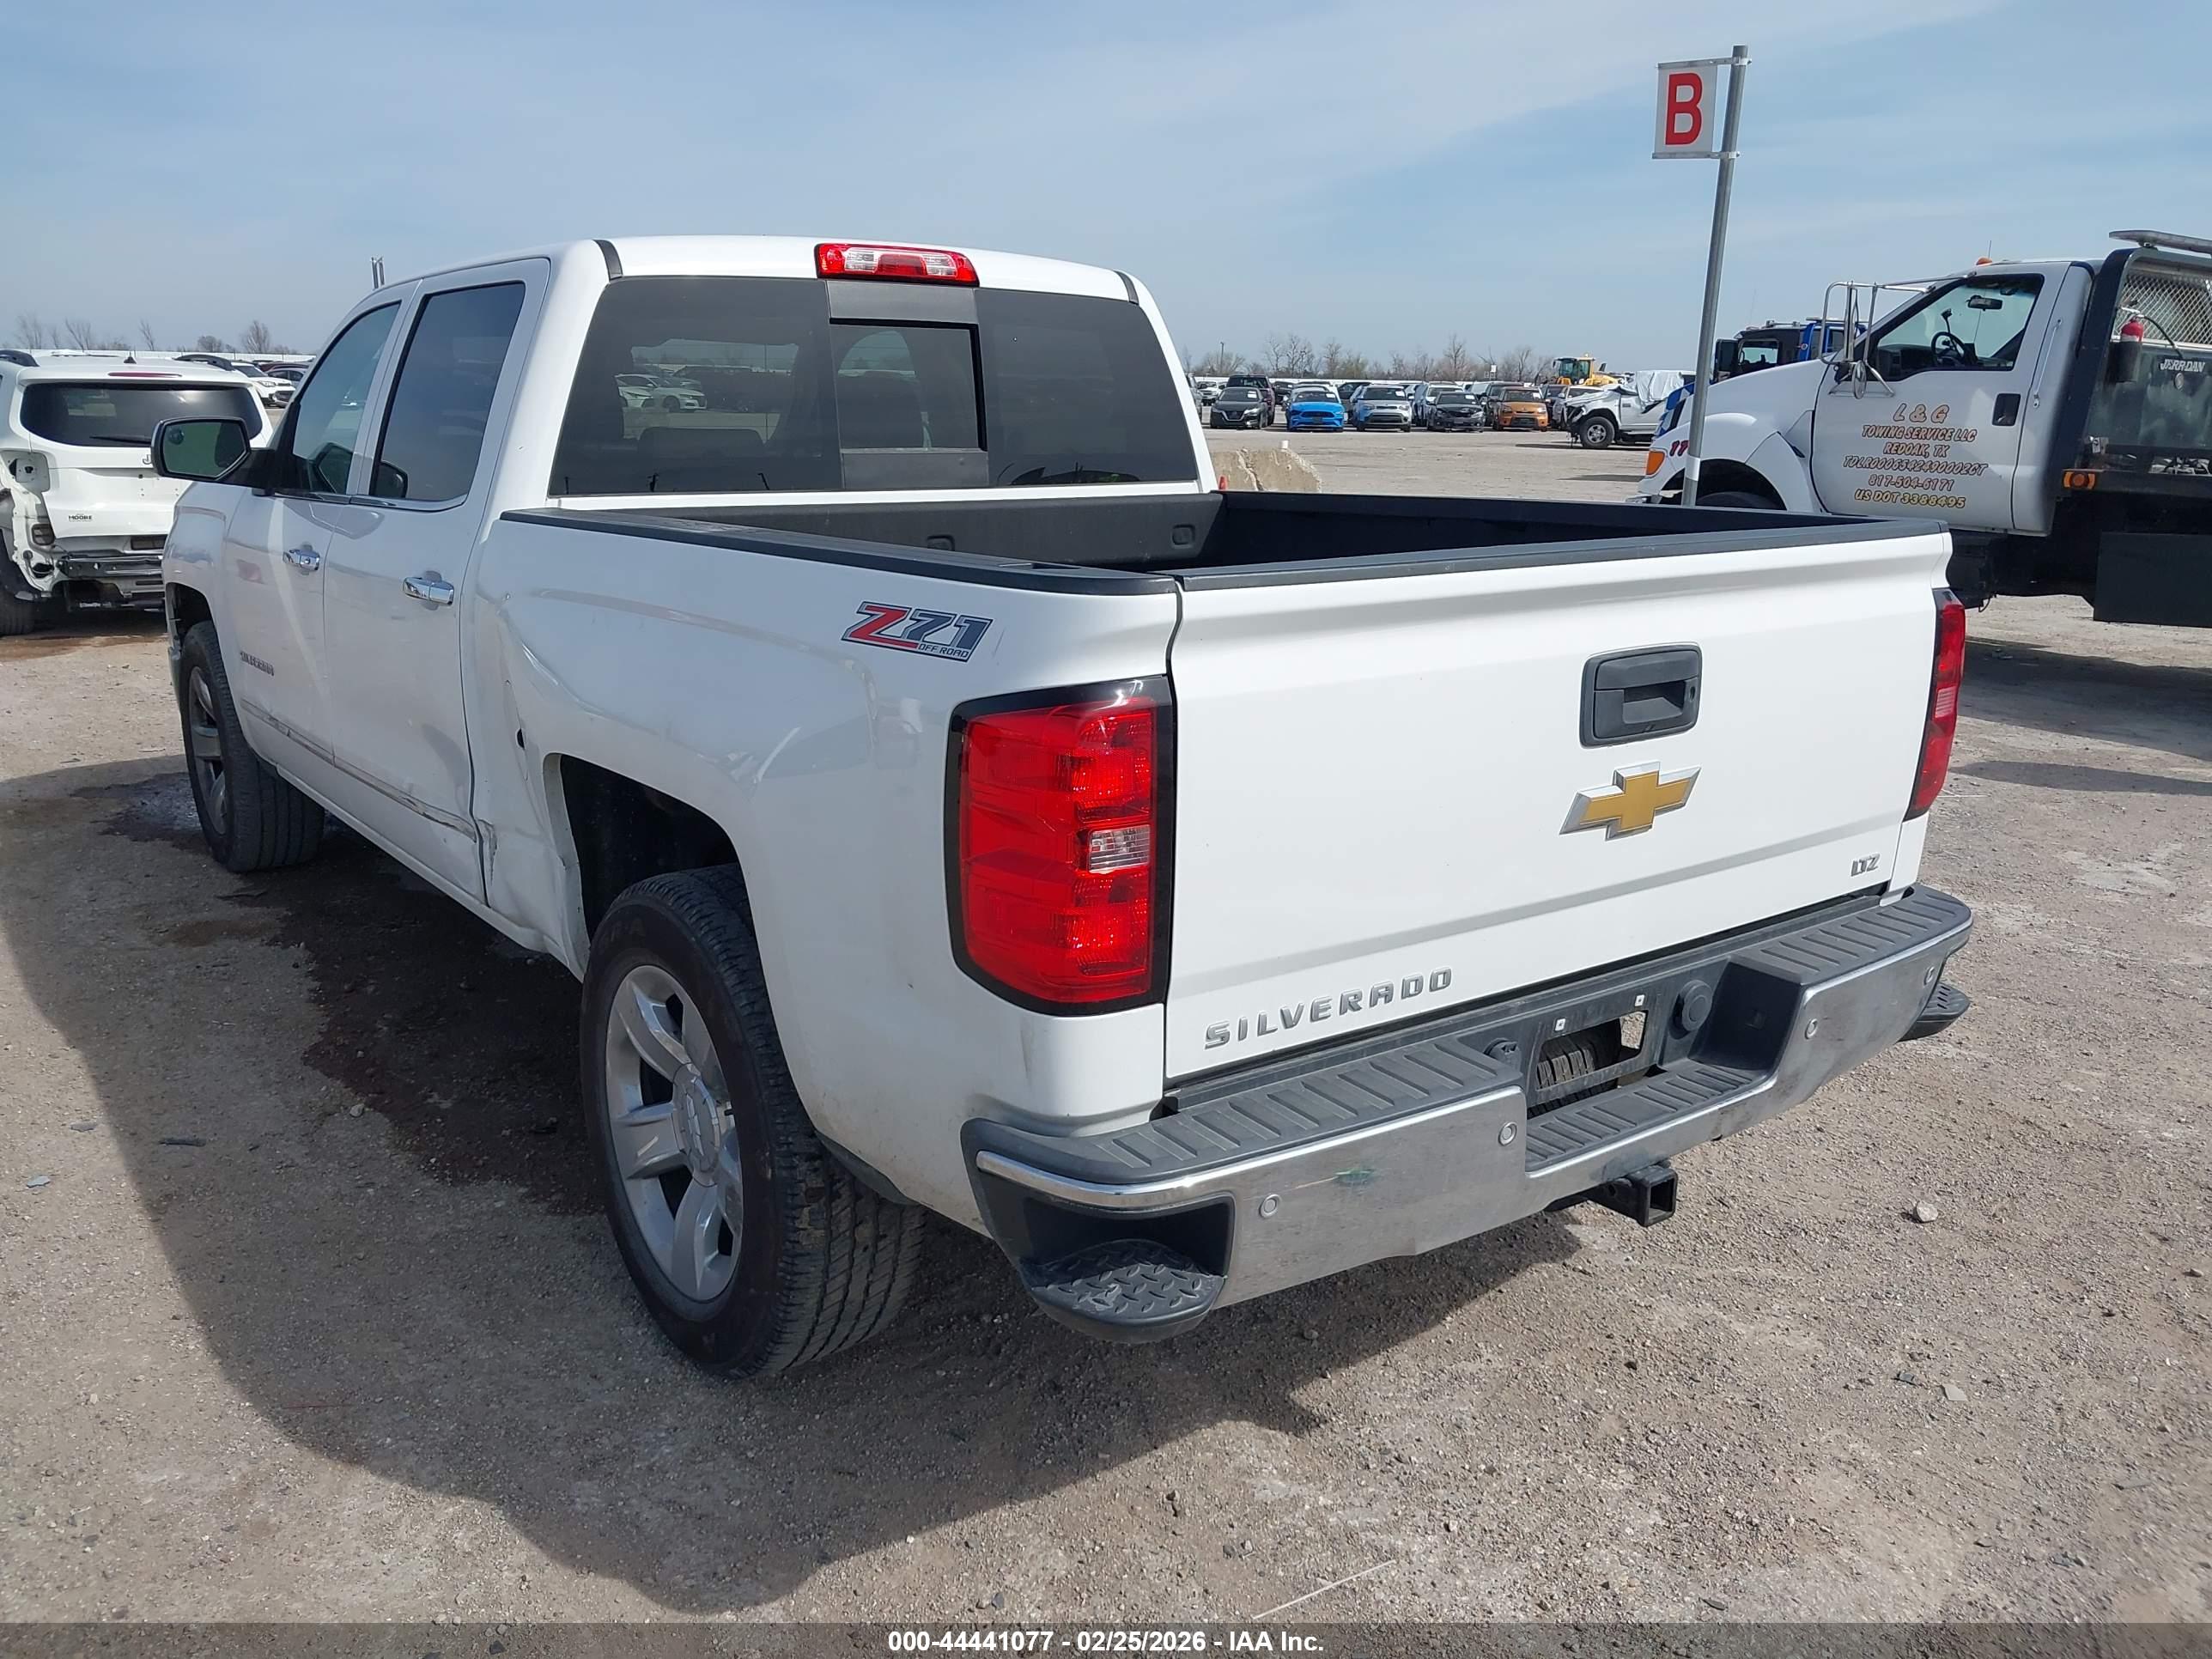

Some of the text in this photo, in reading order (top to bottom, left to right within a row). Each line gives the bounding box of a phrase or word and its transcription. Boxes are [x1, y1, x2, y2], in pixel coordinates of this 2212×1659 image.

[1665, 72, 1703, 145] B
[1893, 403, 1949, 424] L & G
[1862, 425, 1978, 442] TOWING SERVICE LLC
[1933, 445, 1950, 458] TX
[1868, 474, 1954, 491] 817-504-6171
[1855, 489, 1966, 508] US DOT 3388495
[842, 601, 994, 662] Z71
[918, 643, 969, 659] OFF ROAD
[1850, 854, 1881, 877] LTZ
[1204, 966, 1453, 1049] SILVERADO
